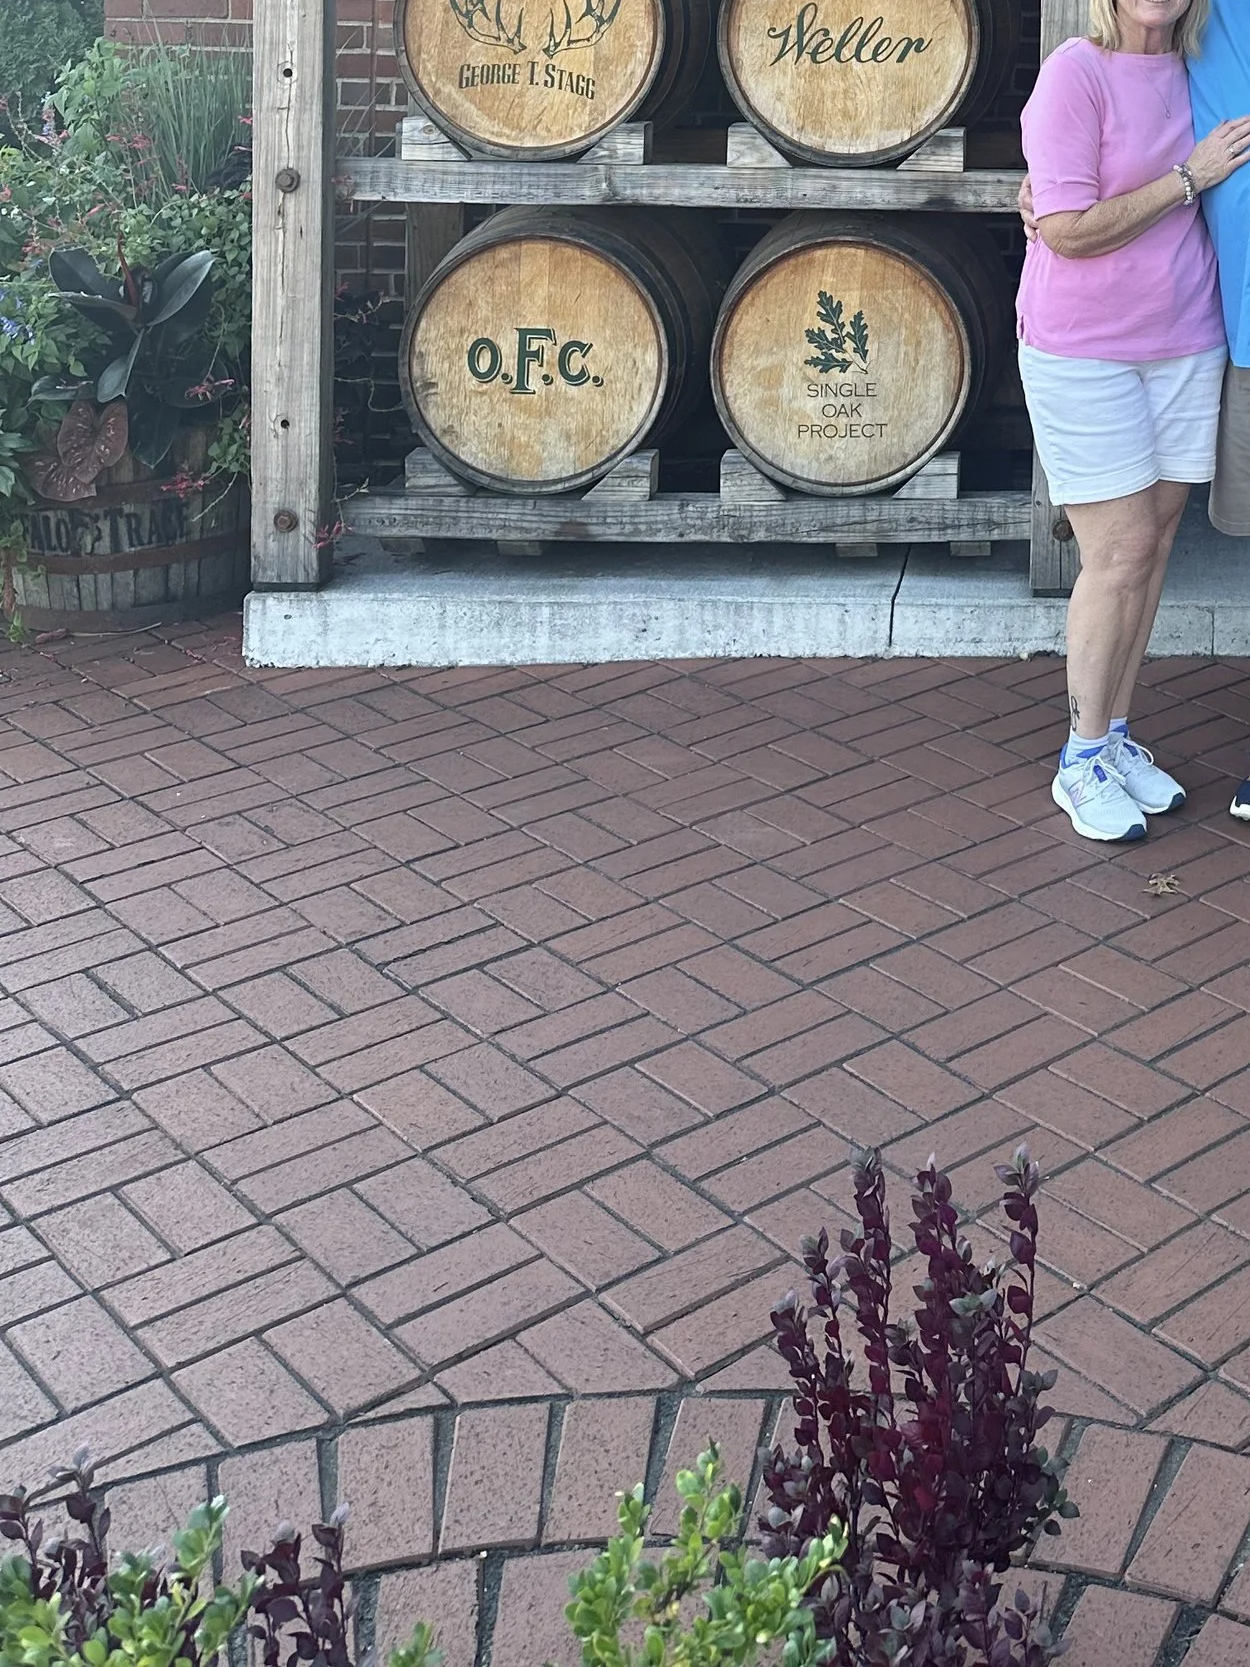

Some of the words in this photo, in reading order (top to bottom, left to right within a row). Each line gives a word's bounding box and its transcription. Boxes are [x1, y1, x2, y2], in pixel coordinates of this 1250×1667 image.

[767, 2, 933, 66] Weller
[458, 63, 521, 89] GEORGE
[528, 60, 539, 86] T.
[544, 63, 596, 100] STAGG
[806, 382, 878, 398] SINGLE
[821, 402, 863, 419] OAK
[797, 423, 888, 439] PROJECT
